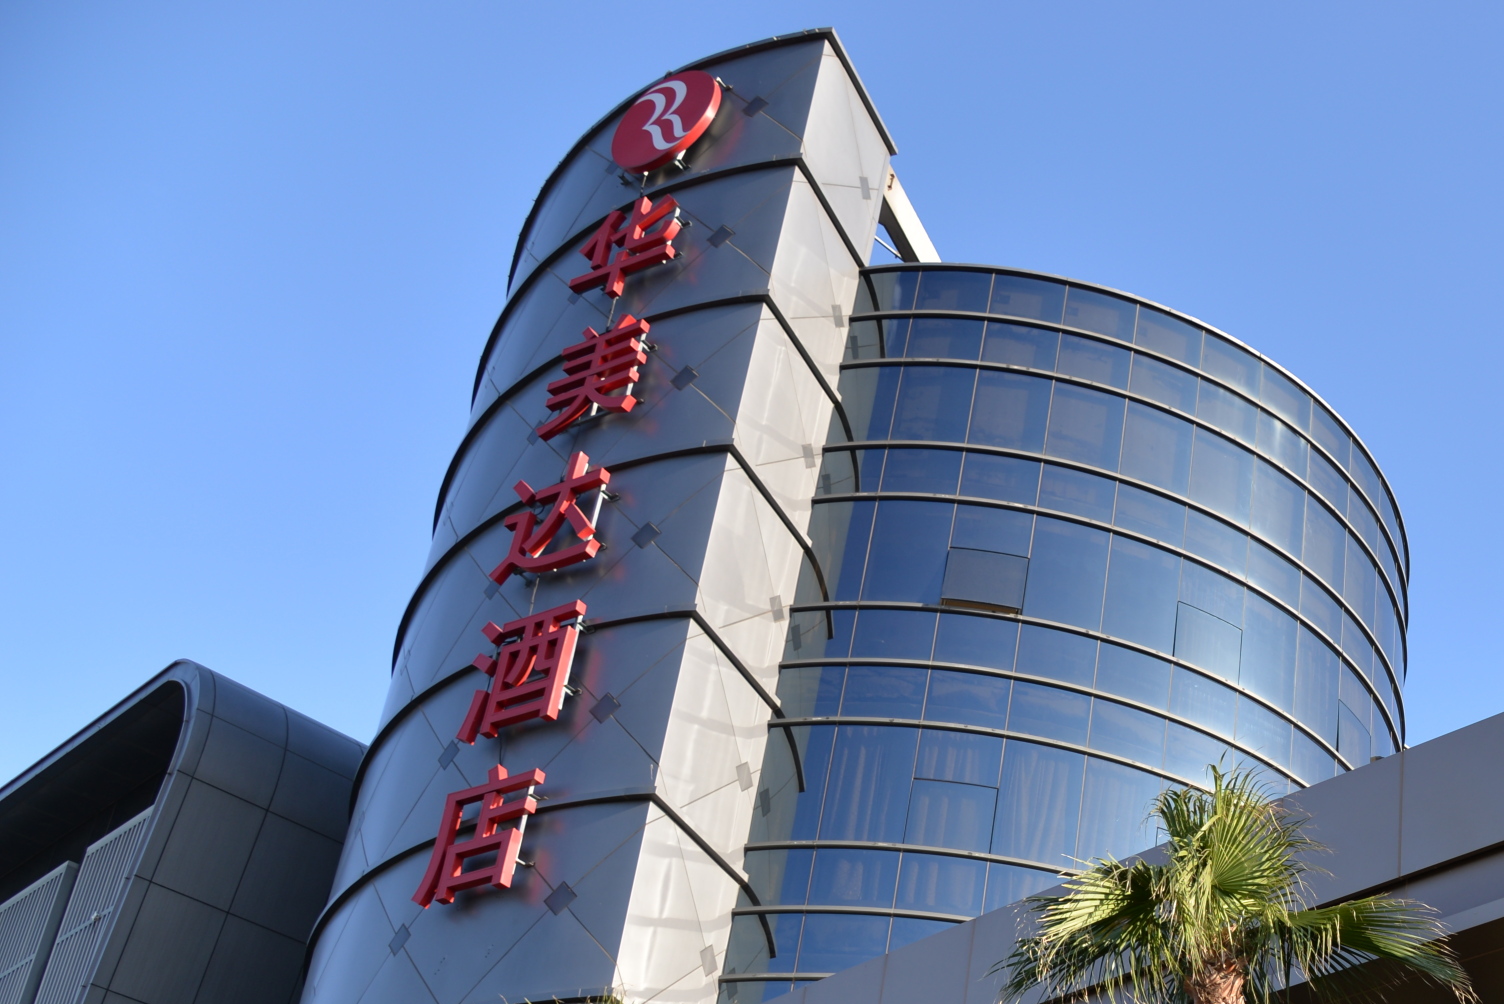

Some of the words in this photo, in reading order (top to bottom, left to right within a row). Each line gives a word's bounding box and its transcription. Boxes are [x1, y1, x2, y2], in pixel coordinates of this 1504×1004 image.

[411, 194, 682, 909] 华美达酒店
